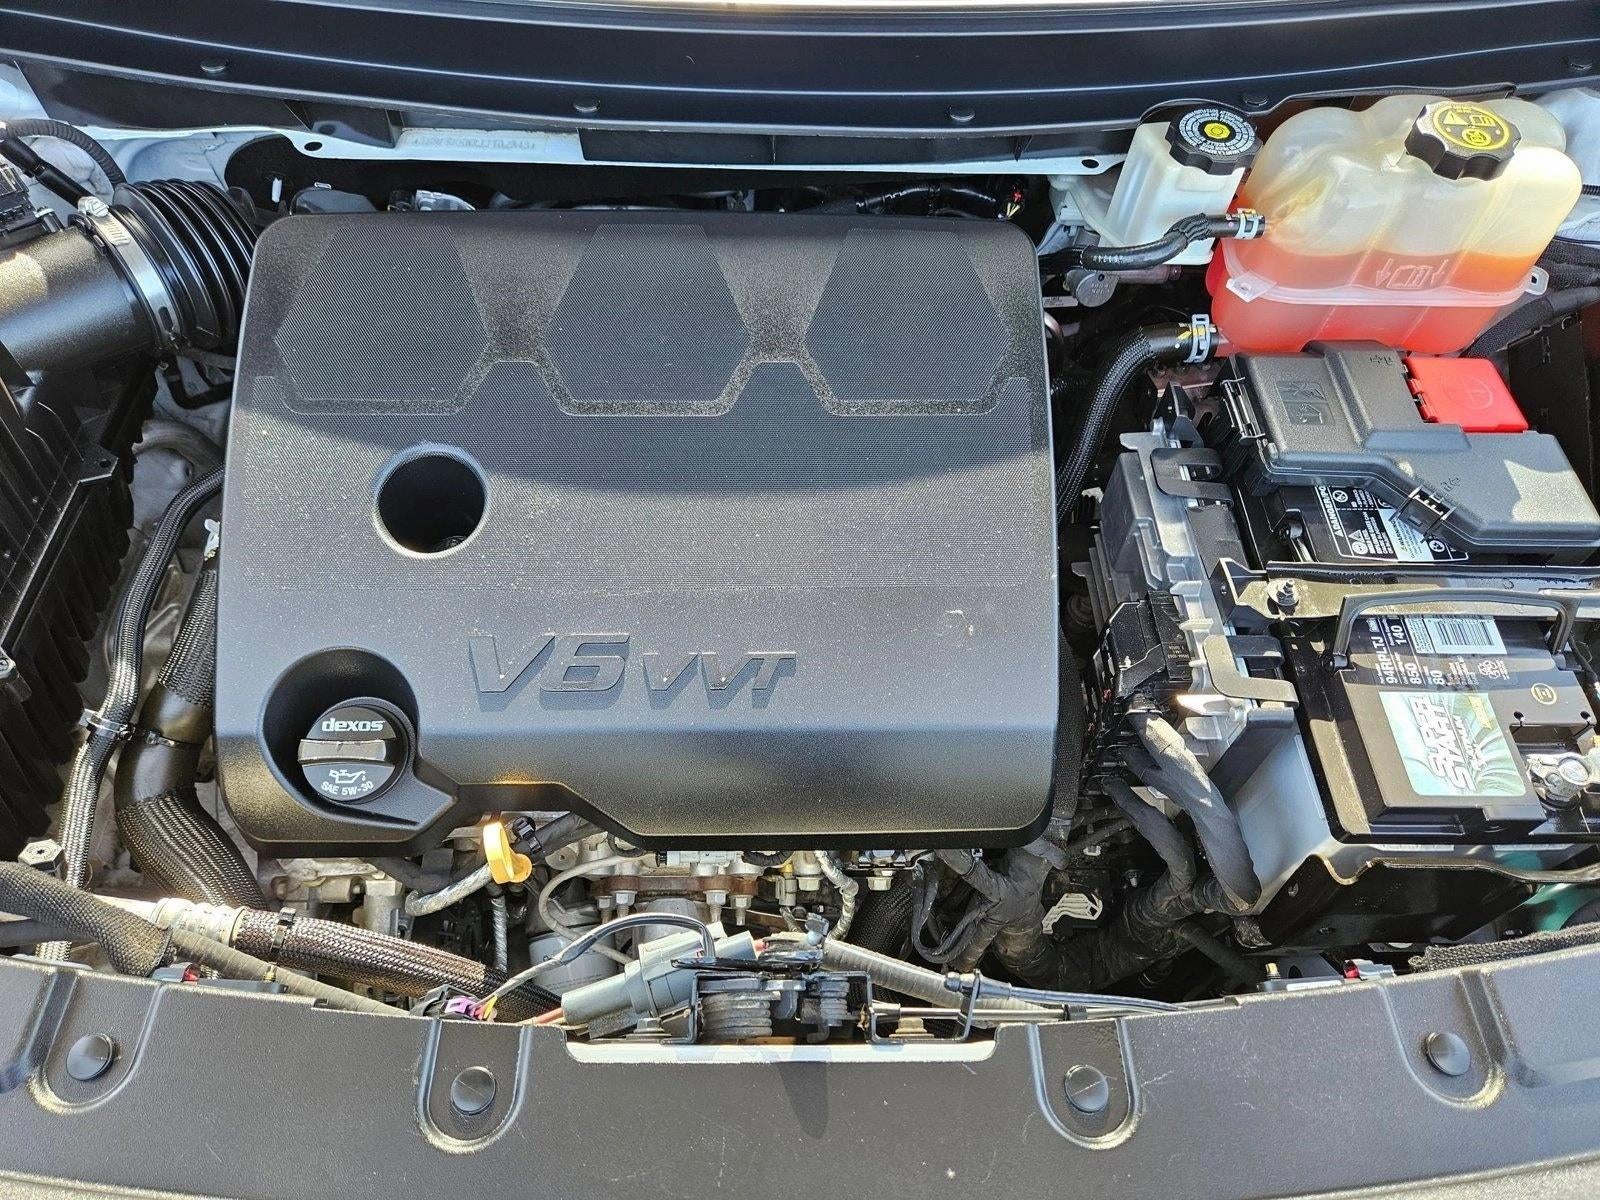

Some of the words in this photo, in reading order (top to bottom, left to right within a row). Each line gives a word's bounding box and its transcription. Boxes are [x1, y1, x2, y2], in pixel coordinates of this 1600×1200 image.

[1390, 625, 1407, 644] 140
[468, 631, 629, 694] V6
[643, 652, 797, 692] VVT
[1371, 636, 1395, 683] 94RPLTJ
[1405, 662, 1422, 684] 850
[1430, 669, 1446, 684] 80
[321, 718, 386, 732] dexos
[1407, 695, 1447, 777] SUPER
[1424, 695, 1477, 790] START
[320, 781, 339, 795] SAE
[341, 781, 374, 796] 5W-30
